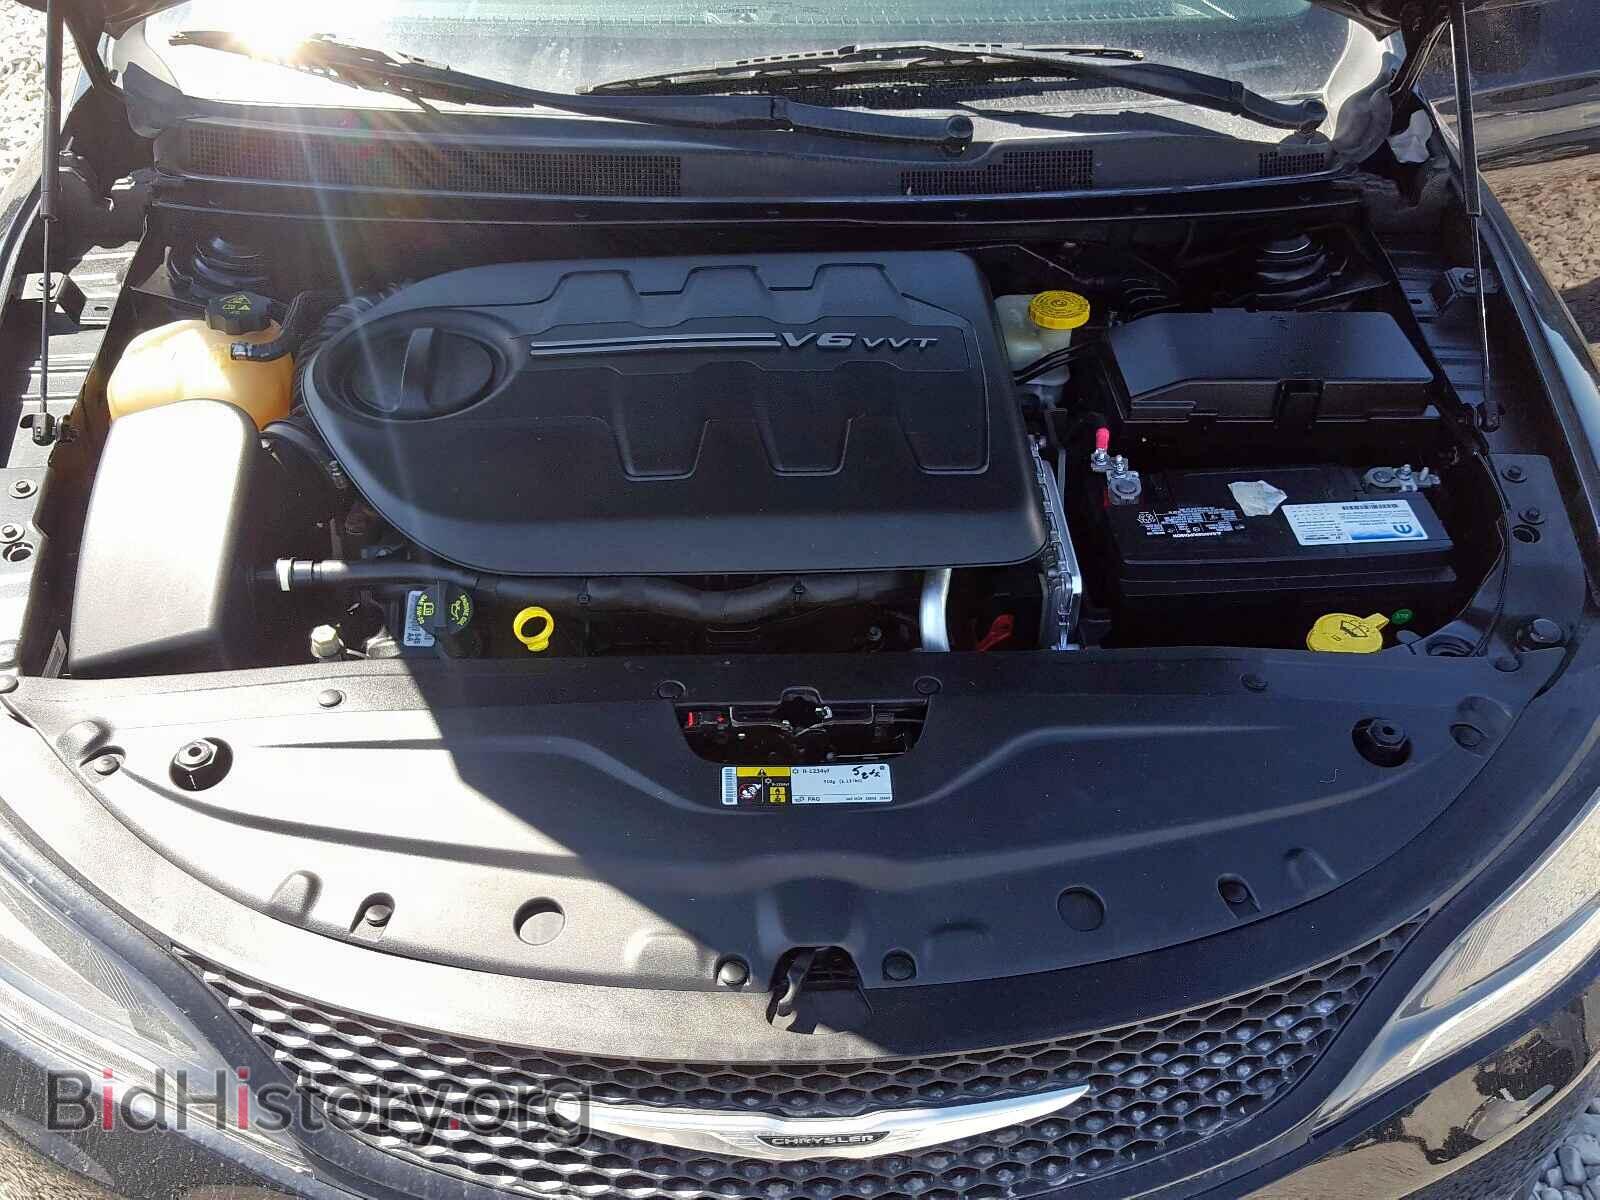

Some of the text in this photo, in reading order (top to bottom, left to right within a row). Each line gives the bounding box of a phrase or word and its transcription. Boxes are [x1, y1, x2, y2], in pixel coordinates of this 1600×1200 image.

[782, 332, 939, 348] V6 VVT
[771, 1135, 874, 1145] CHRYSLER
